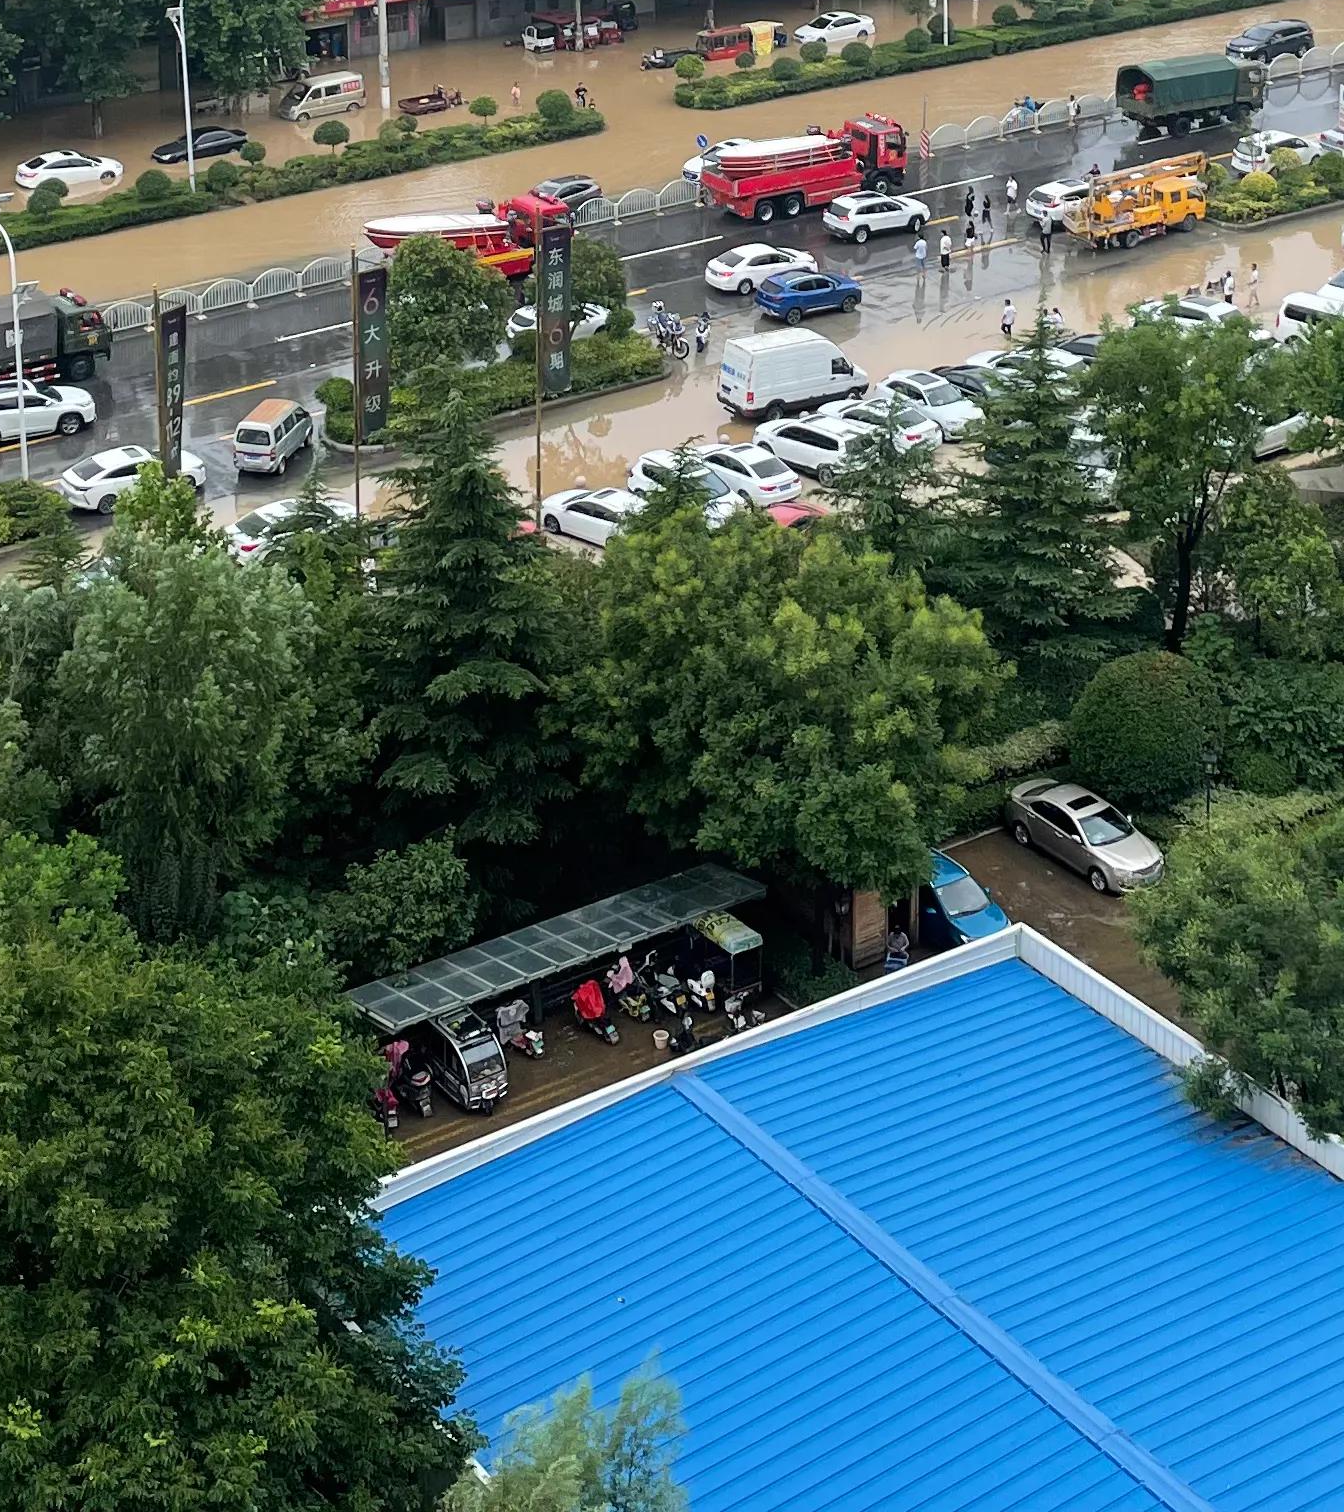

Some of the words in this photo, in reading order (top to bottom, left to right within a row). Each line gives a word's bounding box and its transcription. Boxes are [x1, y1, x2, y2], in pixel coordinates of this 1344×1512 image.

[363, 288, 383, 413] 6大升级
[547, 247, 565, 370] 东润城6期
